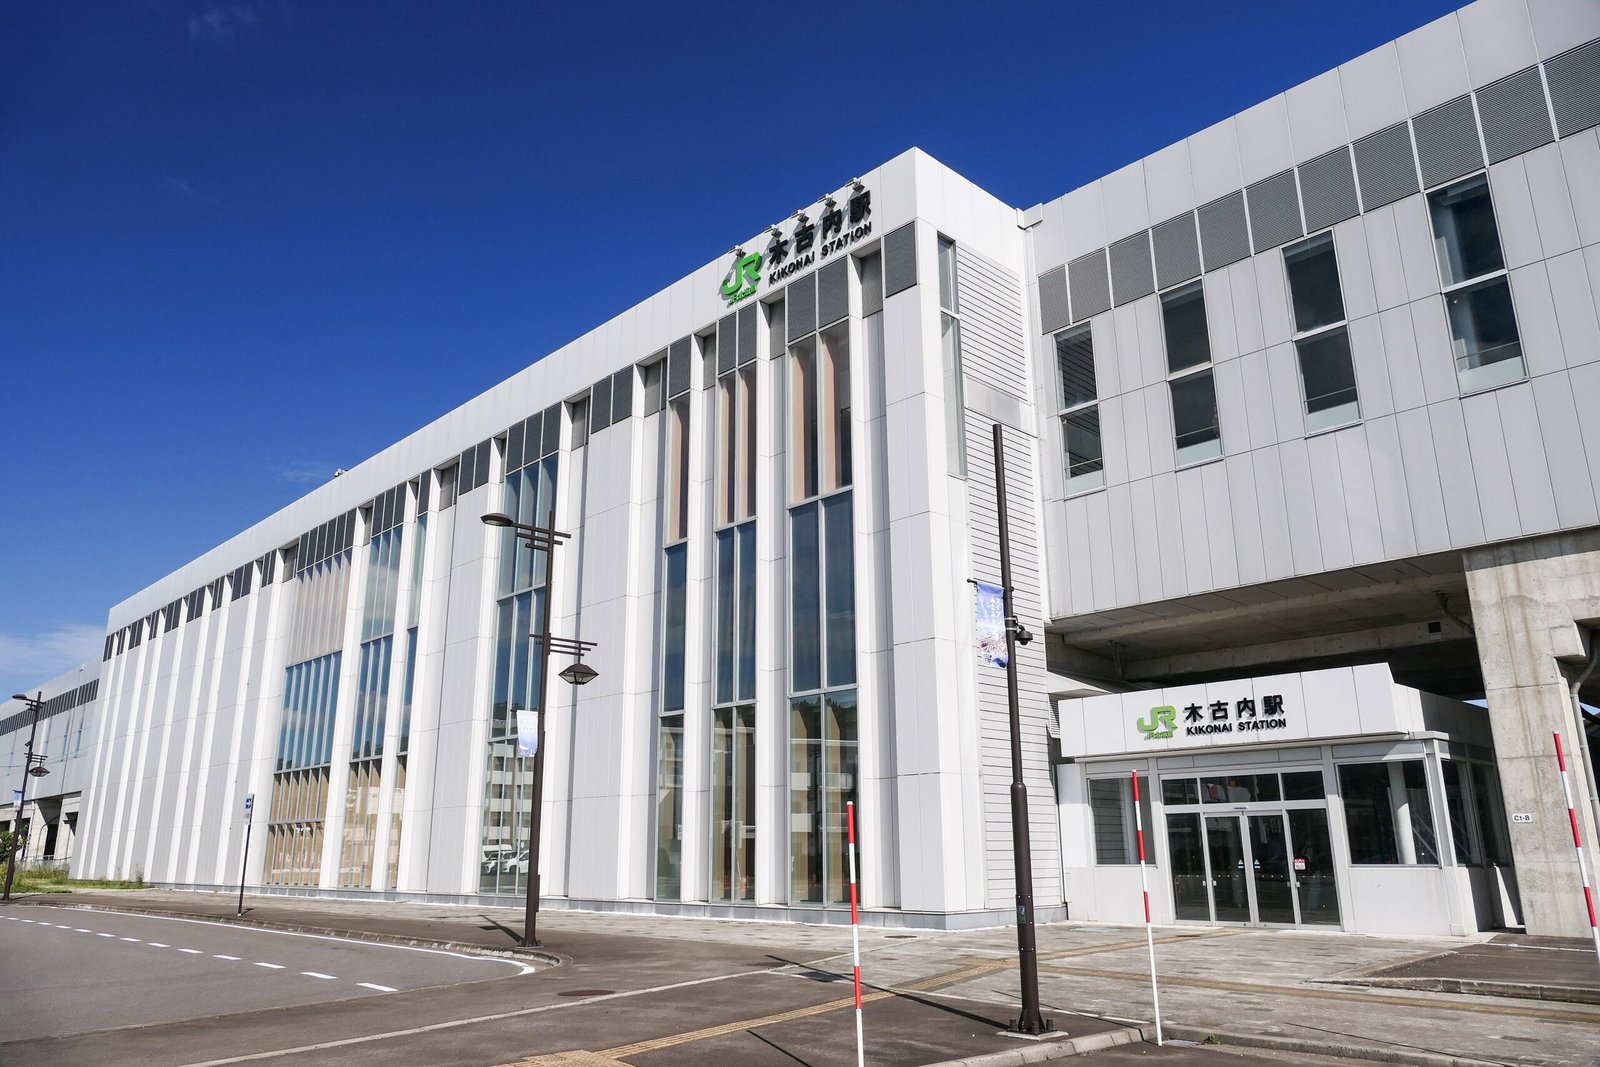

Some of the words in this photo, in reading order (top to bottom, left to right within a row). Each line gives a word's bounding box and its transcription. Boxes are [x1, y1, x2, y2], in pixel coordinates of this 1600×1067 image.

[769, 190, 872, 265] 木古内駅
[769, 251, 815, 285] KIKONAI
[822, 221, 872, 257] STATION
[722, 251, 763, 296] JR
[1138, 705, 1178, 731] JR
[1184, 694, 1285, 723] 木古内駅
[1186, 723, 1233, 736] KIKONAI
[1238, 718, 1287, 731] STATION
